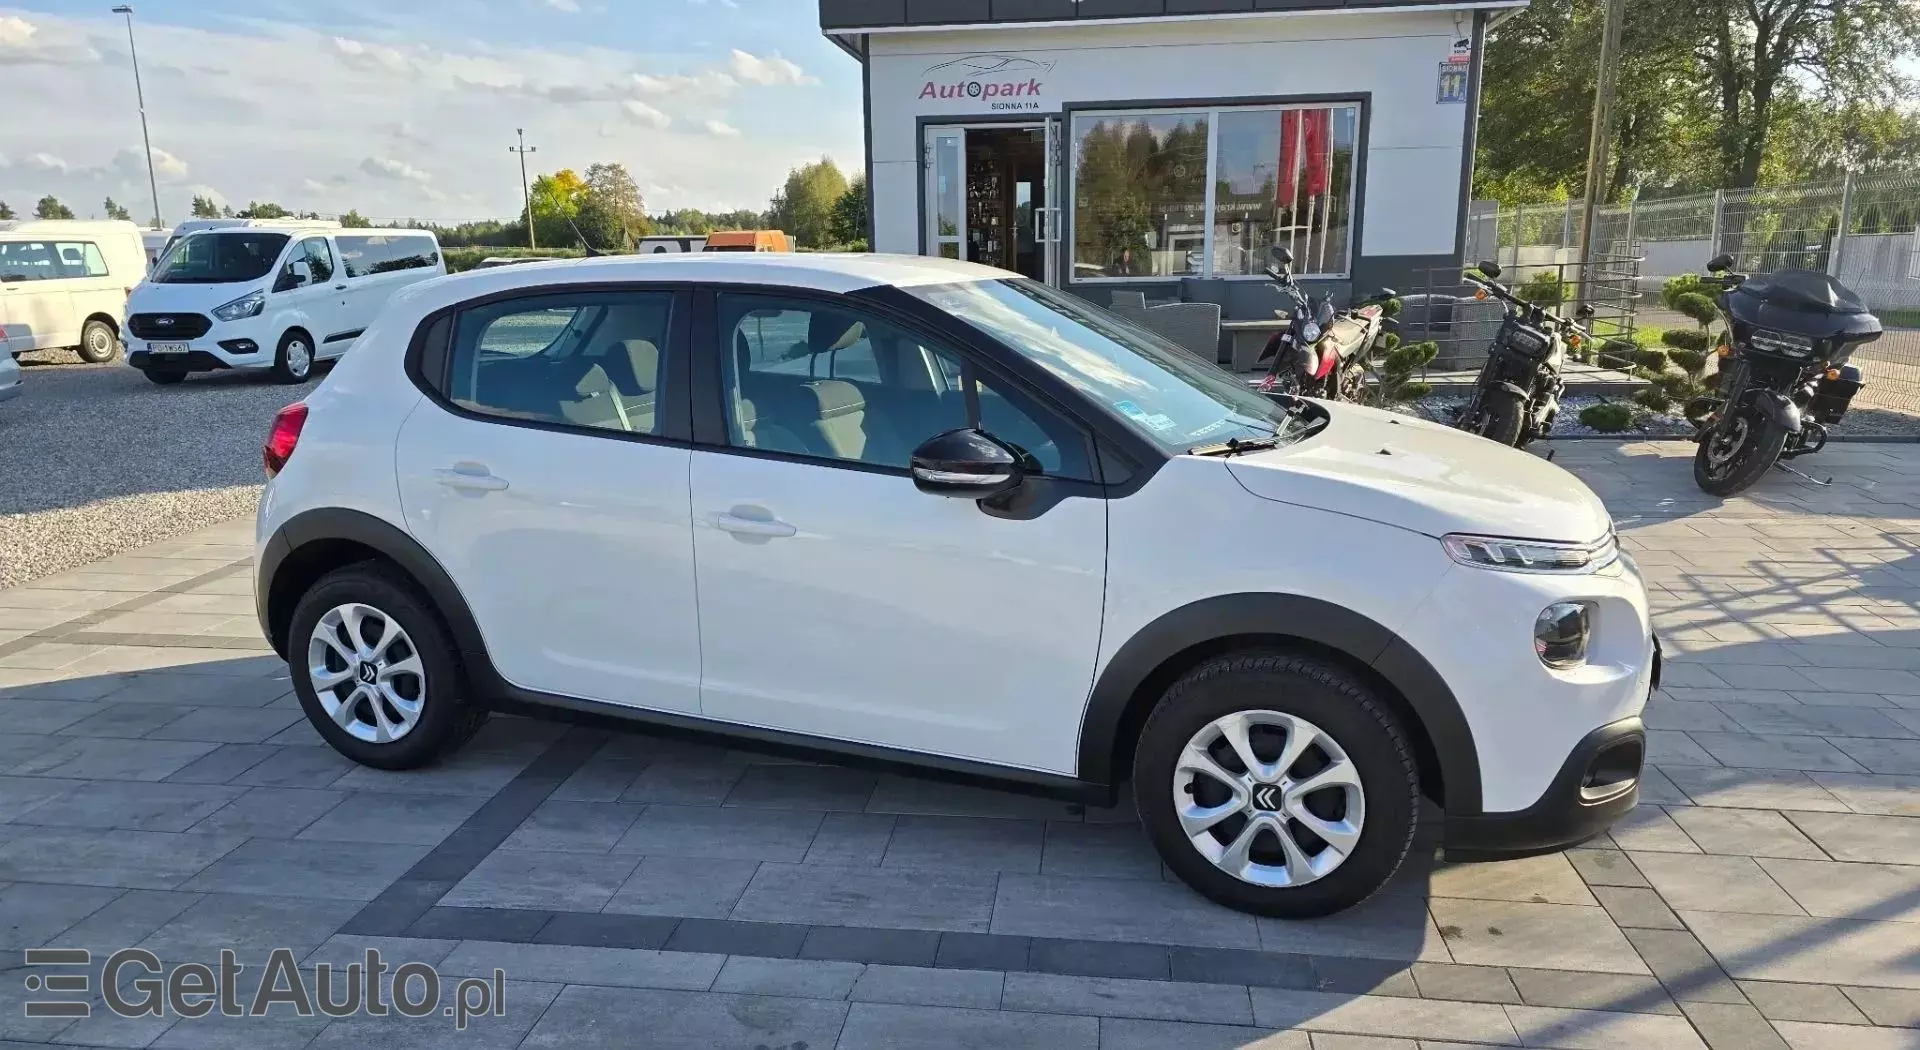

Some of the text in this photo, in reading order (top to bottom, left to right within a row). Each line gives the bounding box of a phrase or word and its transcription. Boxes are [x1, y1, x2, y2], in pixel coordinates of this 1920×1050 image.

[918, 78, 1043, 101] Autopark
[991, 101, 1039, 110] SIONNA 11A
